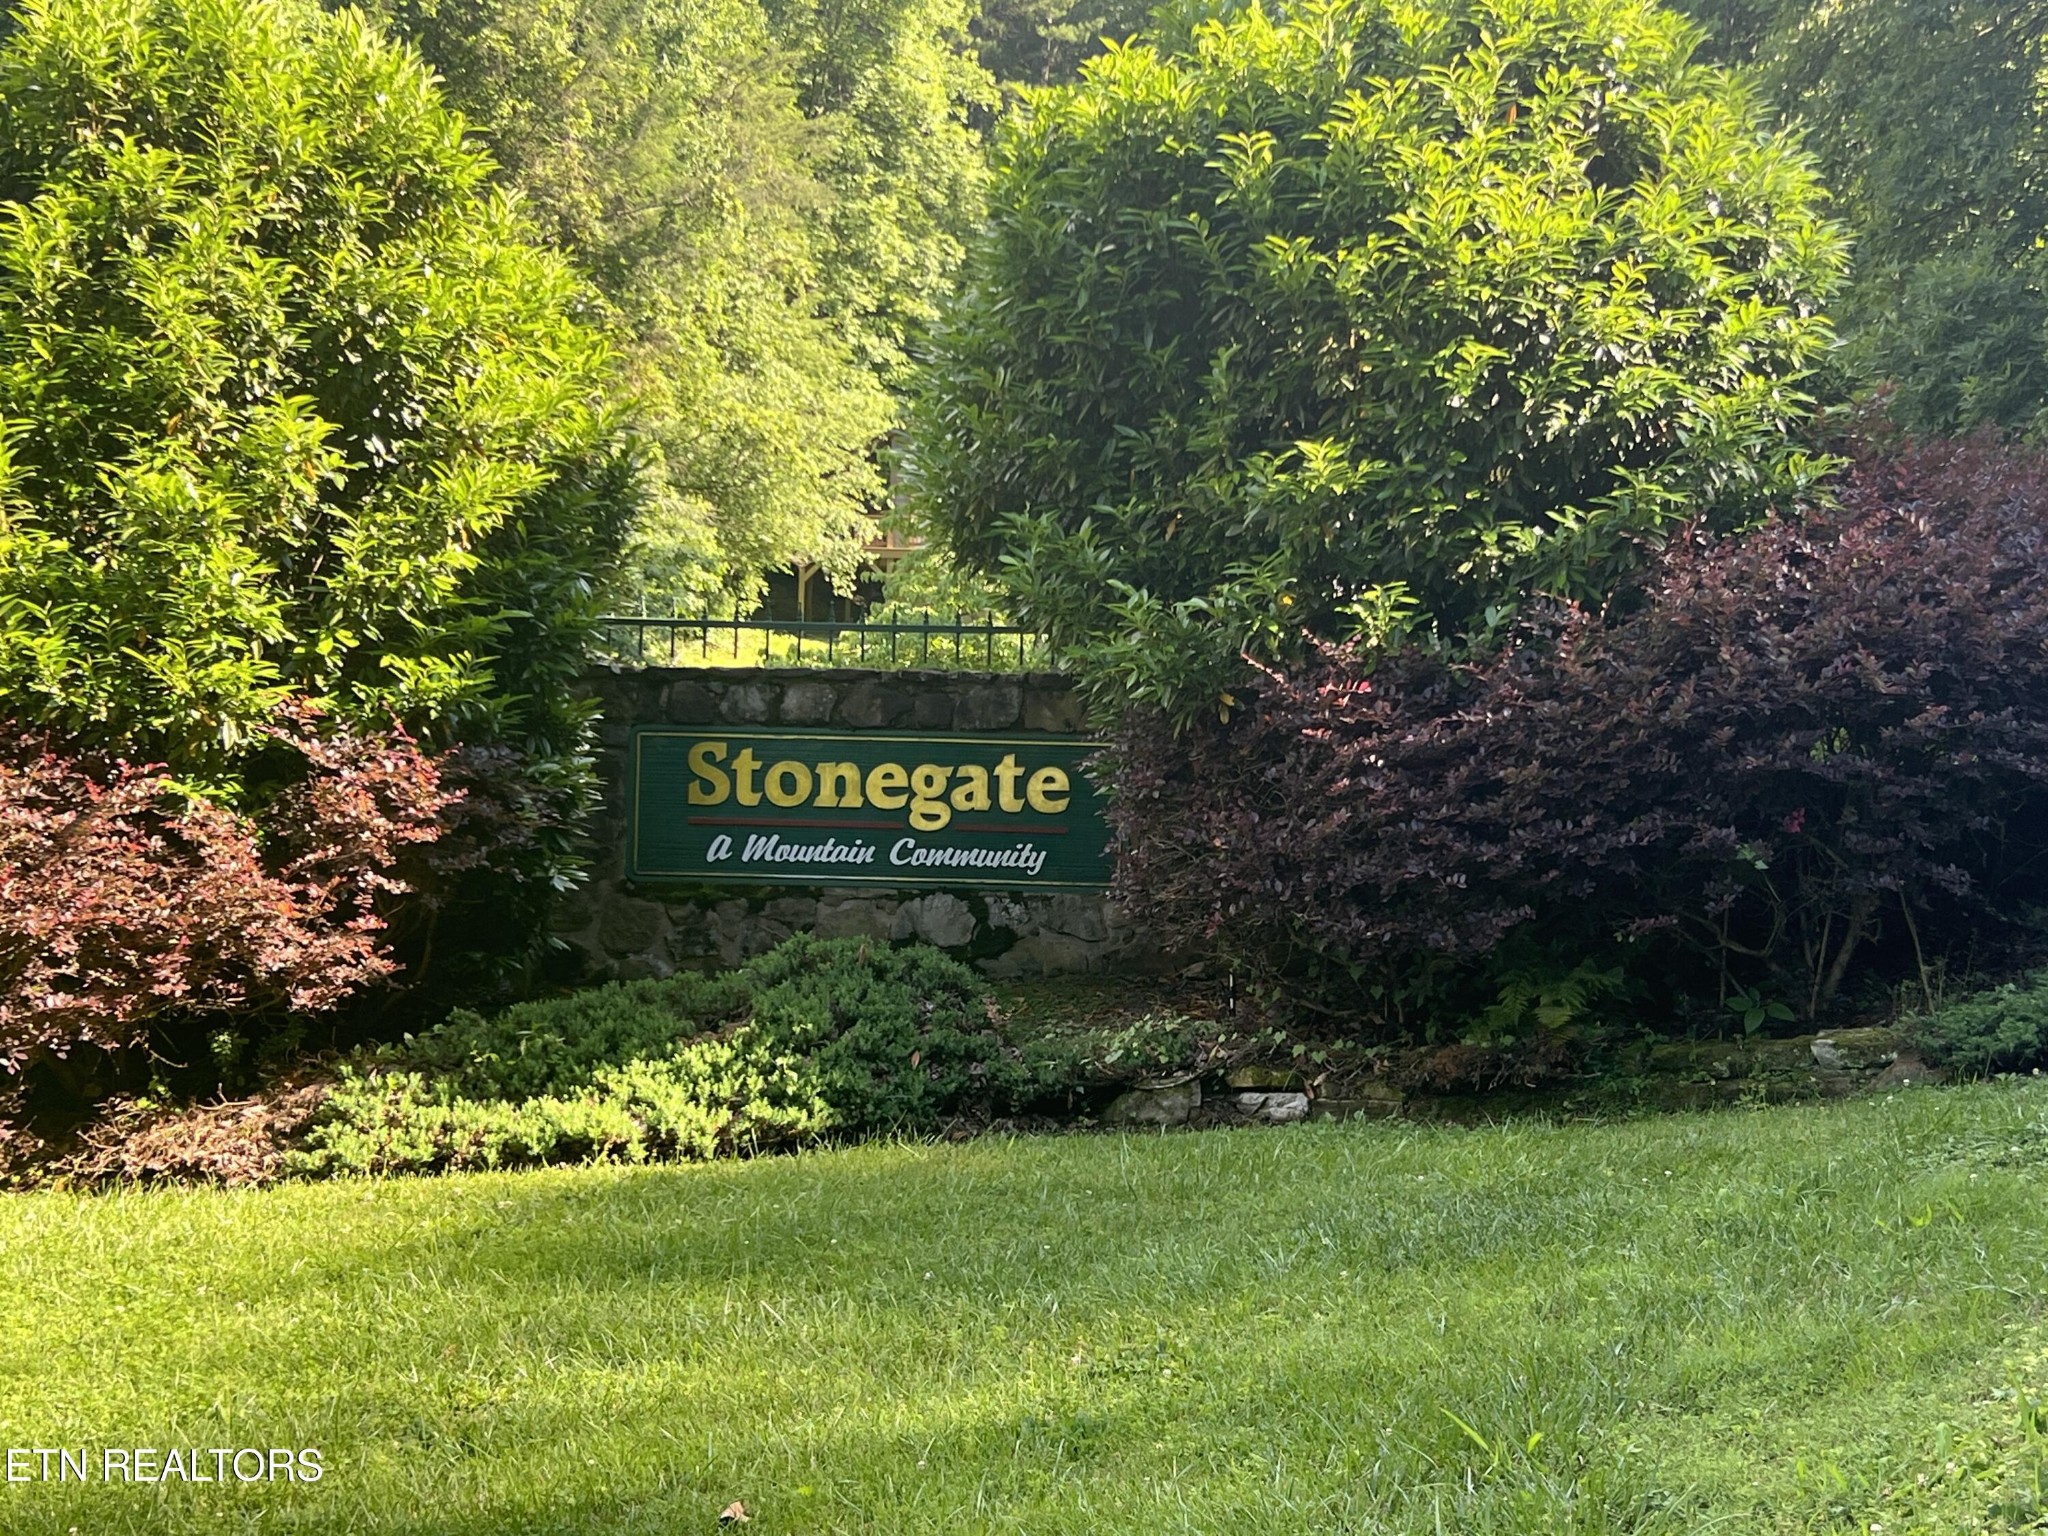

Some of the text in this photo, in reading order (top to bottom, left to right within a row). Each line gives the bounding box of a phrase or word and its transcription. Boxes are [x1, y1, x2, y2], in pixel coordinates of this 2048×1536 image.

[687, 741, 1071, 831] Stonegate
[706, 834, 1048, 875] A Mountain Community
